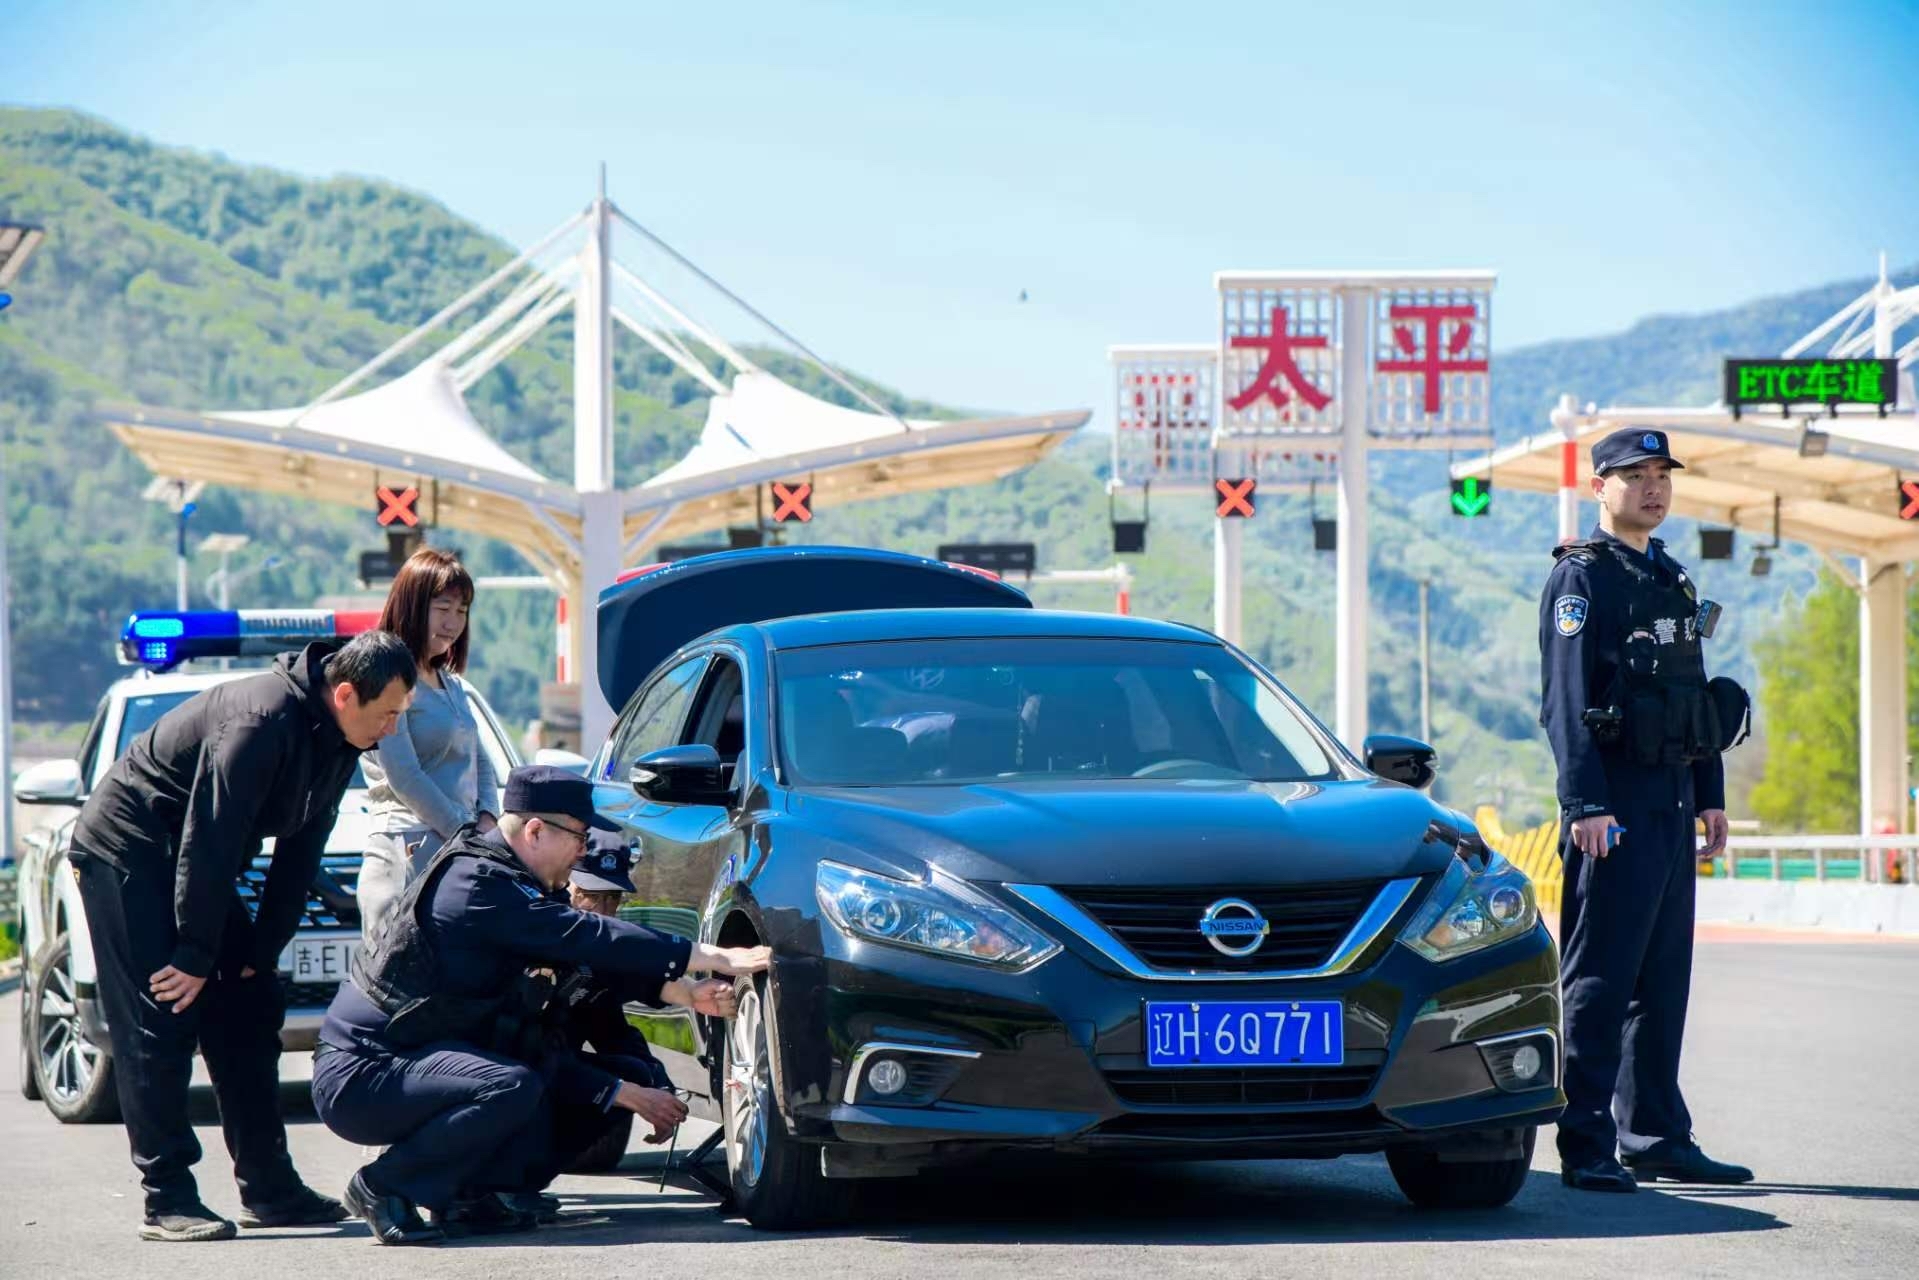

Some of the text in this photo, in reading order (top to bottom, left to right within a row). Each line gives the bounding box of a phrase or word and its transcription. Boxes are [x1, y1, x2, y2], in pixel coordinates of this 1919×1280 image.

[1228, 305, 1489, 413] 太平
[1738, 362, 1885, 403] ETC车道
[1208, 921, 1264, 932] NISSAN
[297, 945, 350, 975] 吉·E1
